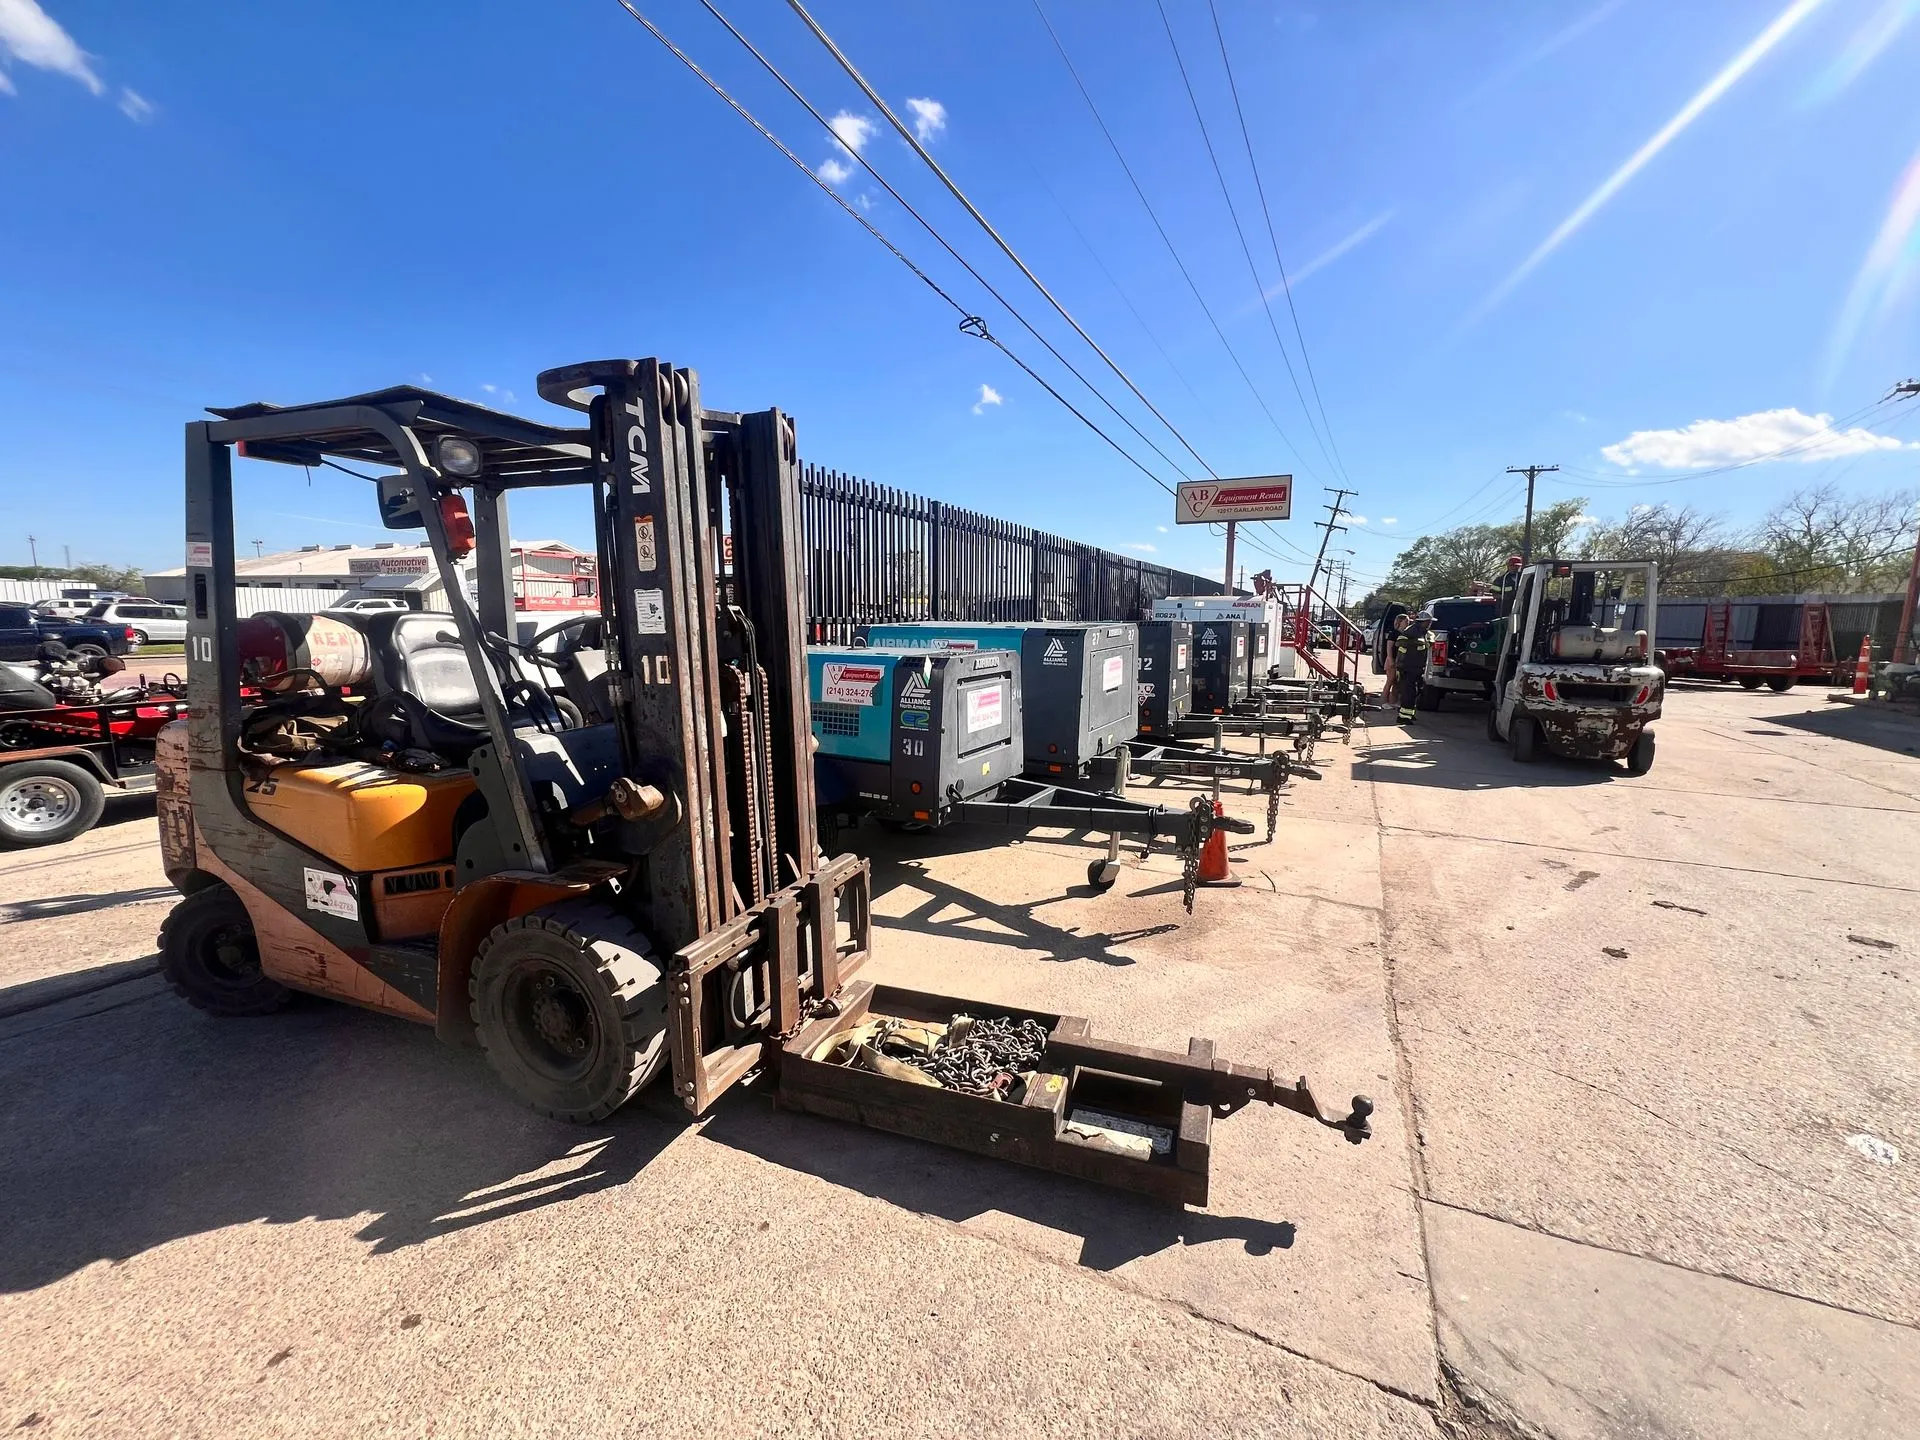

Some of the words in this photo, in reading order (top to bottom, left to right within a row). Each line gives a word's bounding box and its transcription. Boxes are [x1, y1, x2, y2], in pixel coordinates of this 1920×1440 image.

[625, 396, 651, 494] TCM
[1218, 493, 1258, 504] Equipment
[1259, 490, 1284, 500] Rental
[1234, 505, 1263, 513] GARLAND
[1265, 504, 1284, 512] ROAD
[380, 558, 427, 567] Automotive
[192, 636, 213, 662] 10
[873, 638, 931, 649] AIRMAN
[1202, 650, 1217, 661] 33
[641, 655, 672, 684] 10
[826, 686, 844, 697] (214)
[900, 697, 931, 706] ALLIANCE
[903, 738, 924, 757] 30
